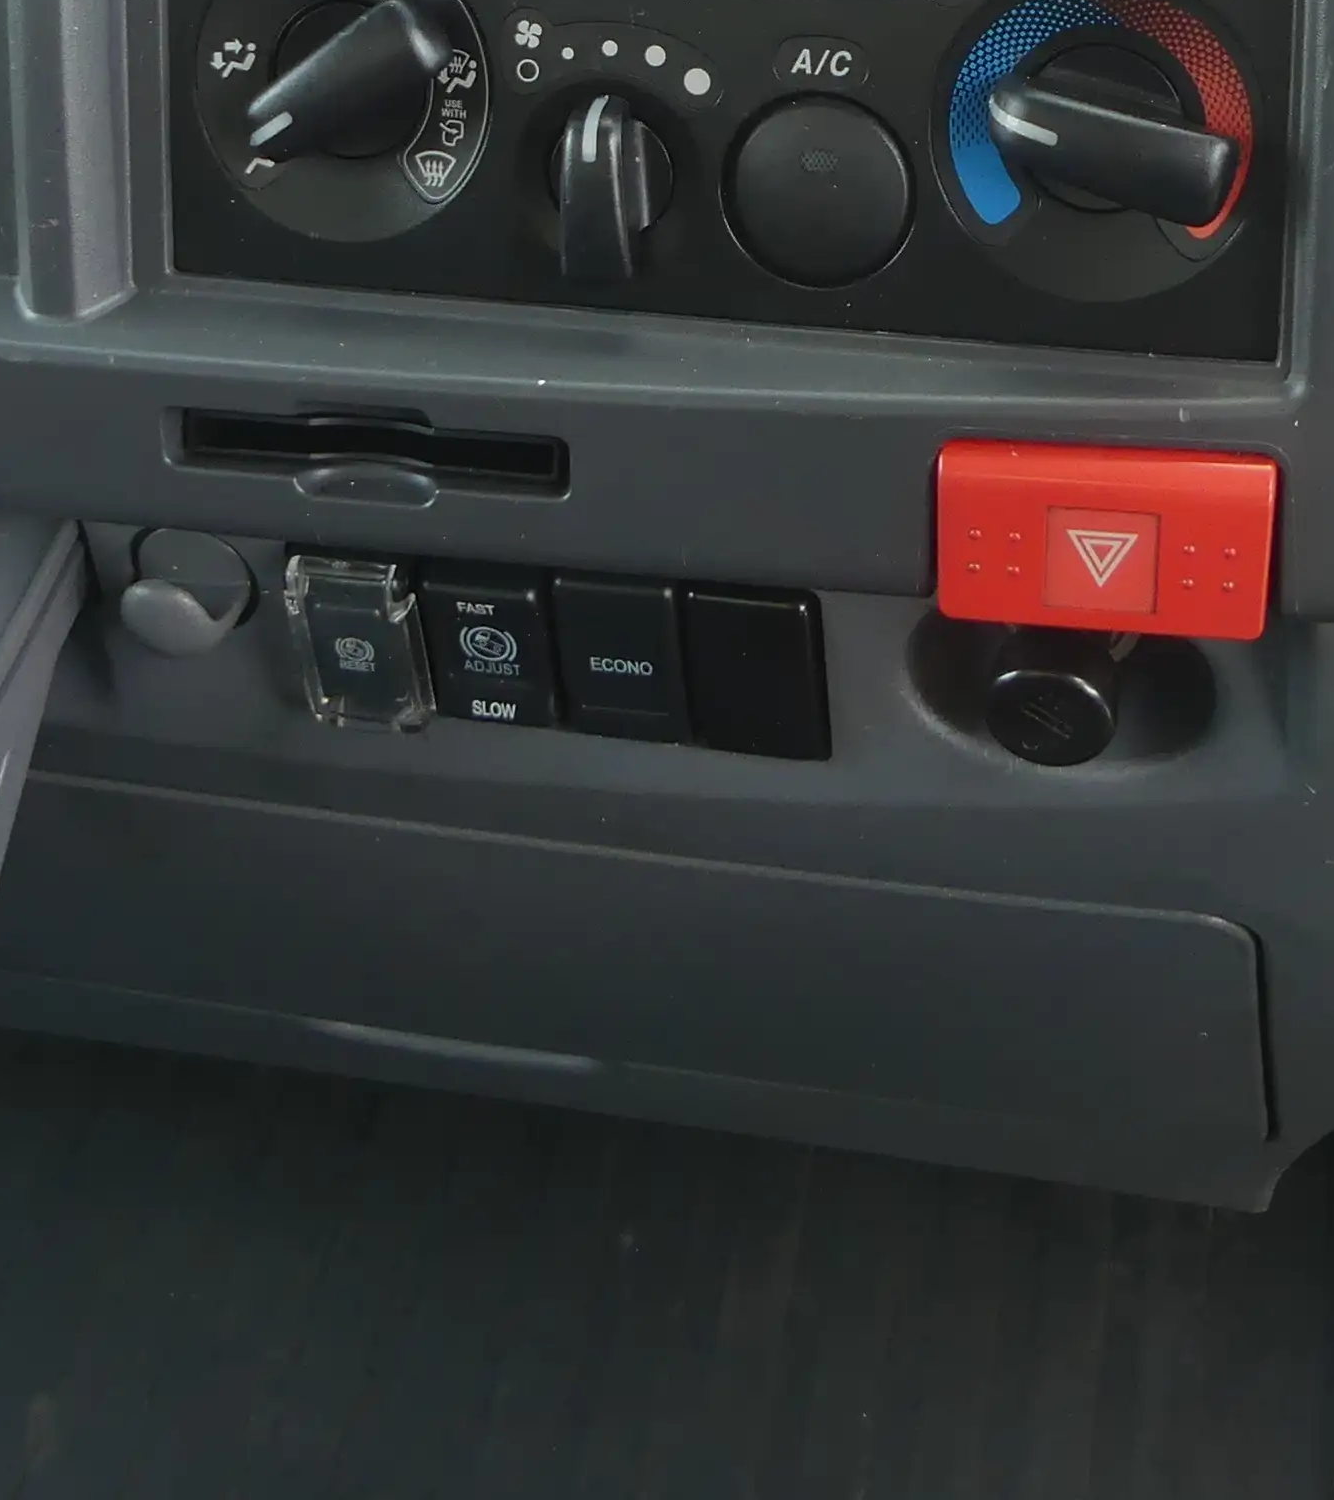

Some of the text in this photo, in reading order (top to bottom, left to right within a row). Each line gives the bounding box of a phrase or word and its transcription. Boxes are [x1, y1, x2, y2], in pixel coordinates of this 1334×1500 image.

[790, 48, 854, 77] A/C
[444, 99, 464, 109] USE
[441, 107, 467, 119] WITH
[456, 601, 495, 616] FAST
[339, 659, 376, 672] RESET
[463, 658, 521, 676] ADJUST
[589, 656, 654, 677] ECONO
[471, 699, 516, 719] SLOW
